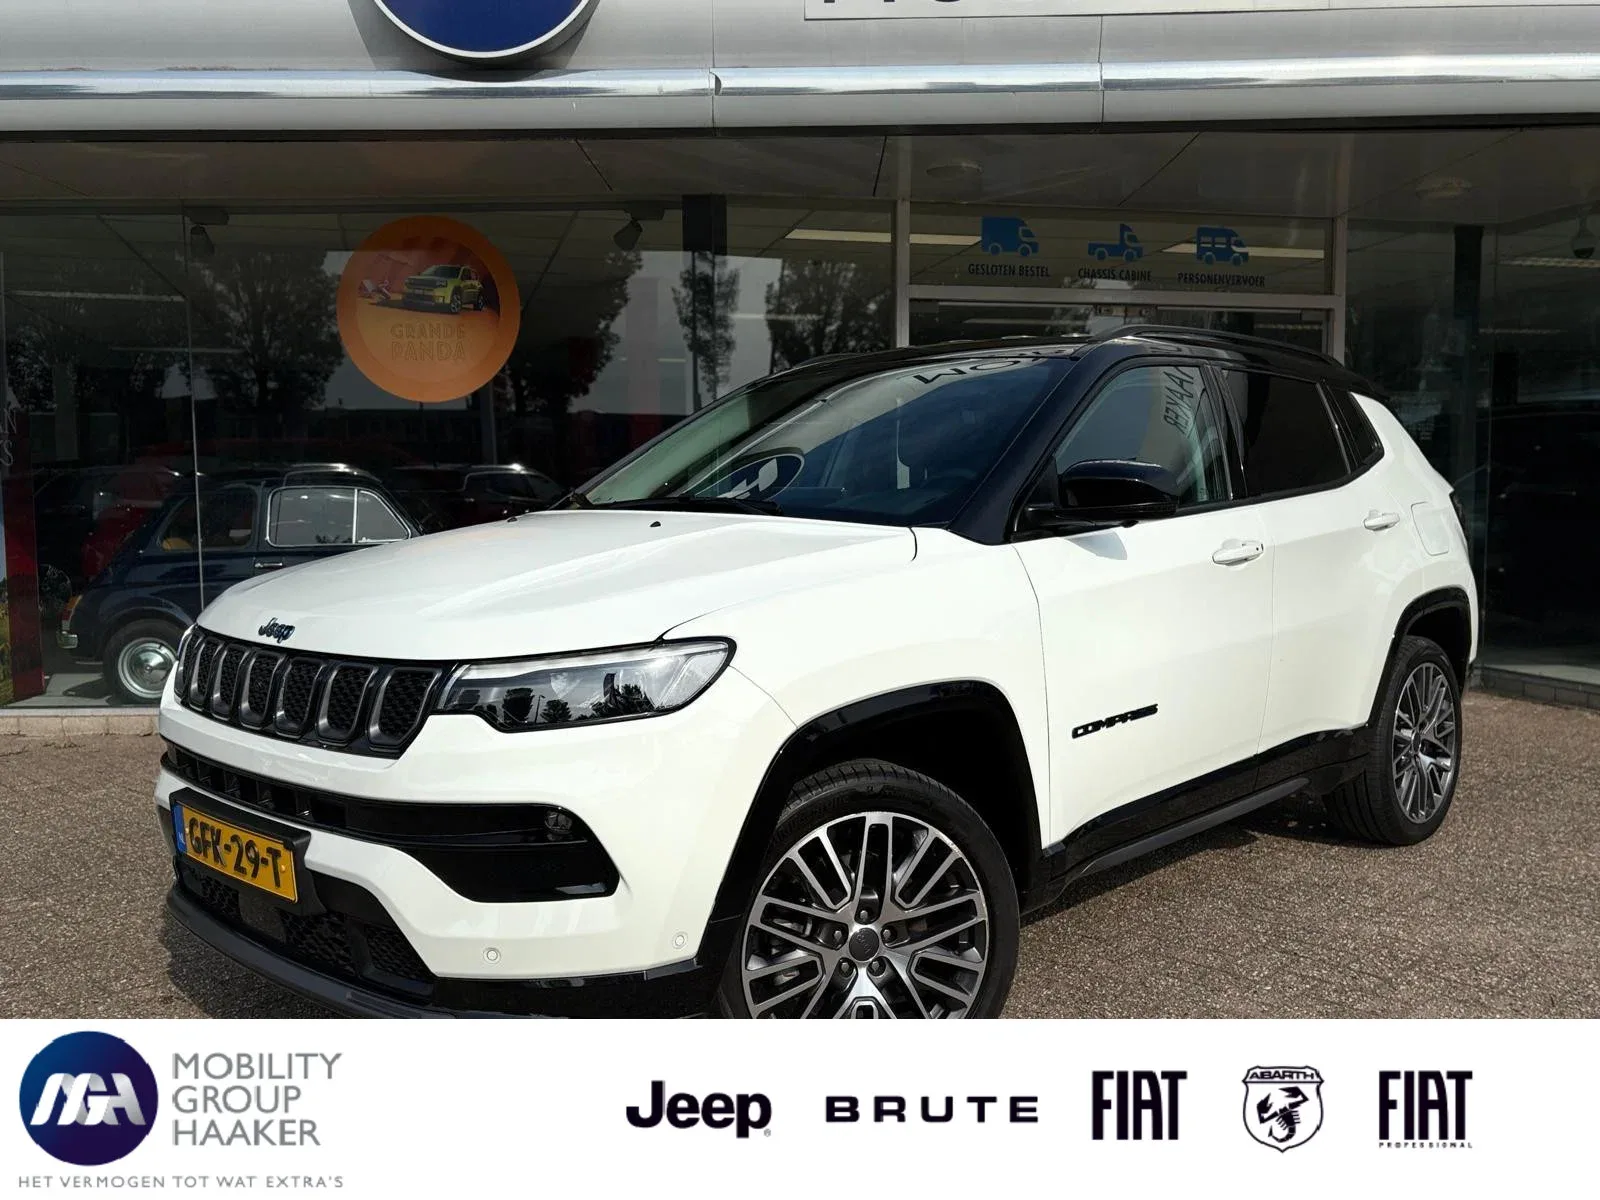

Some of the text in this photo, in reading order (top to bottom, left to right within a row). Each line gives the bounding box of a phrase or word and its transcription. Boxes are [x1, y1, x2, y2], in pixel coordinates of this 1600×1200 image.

[968, 264, 1050, 278] GESLOTEN BESTEL
[1078, 267, 1152, 281] CHASSIS CABINE
[1178, 272, 1266, 287] PERSONENVERVOER
[390, 322, 465, 339] GRANDE
[391, 340, 465, 361] PANDA
[258, 617, 295, 644] Jeep
[1071, 703, 1158, 739] COMPASS
[189, 817, 282, 888] GFK-29-T
